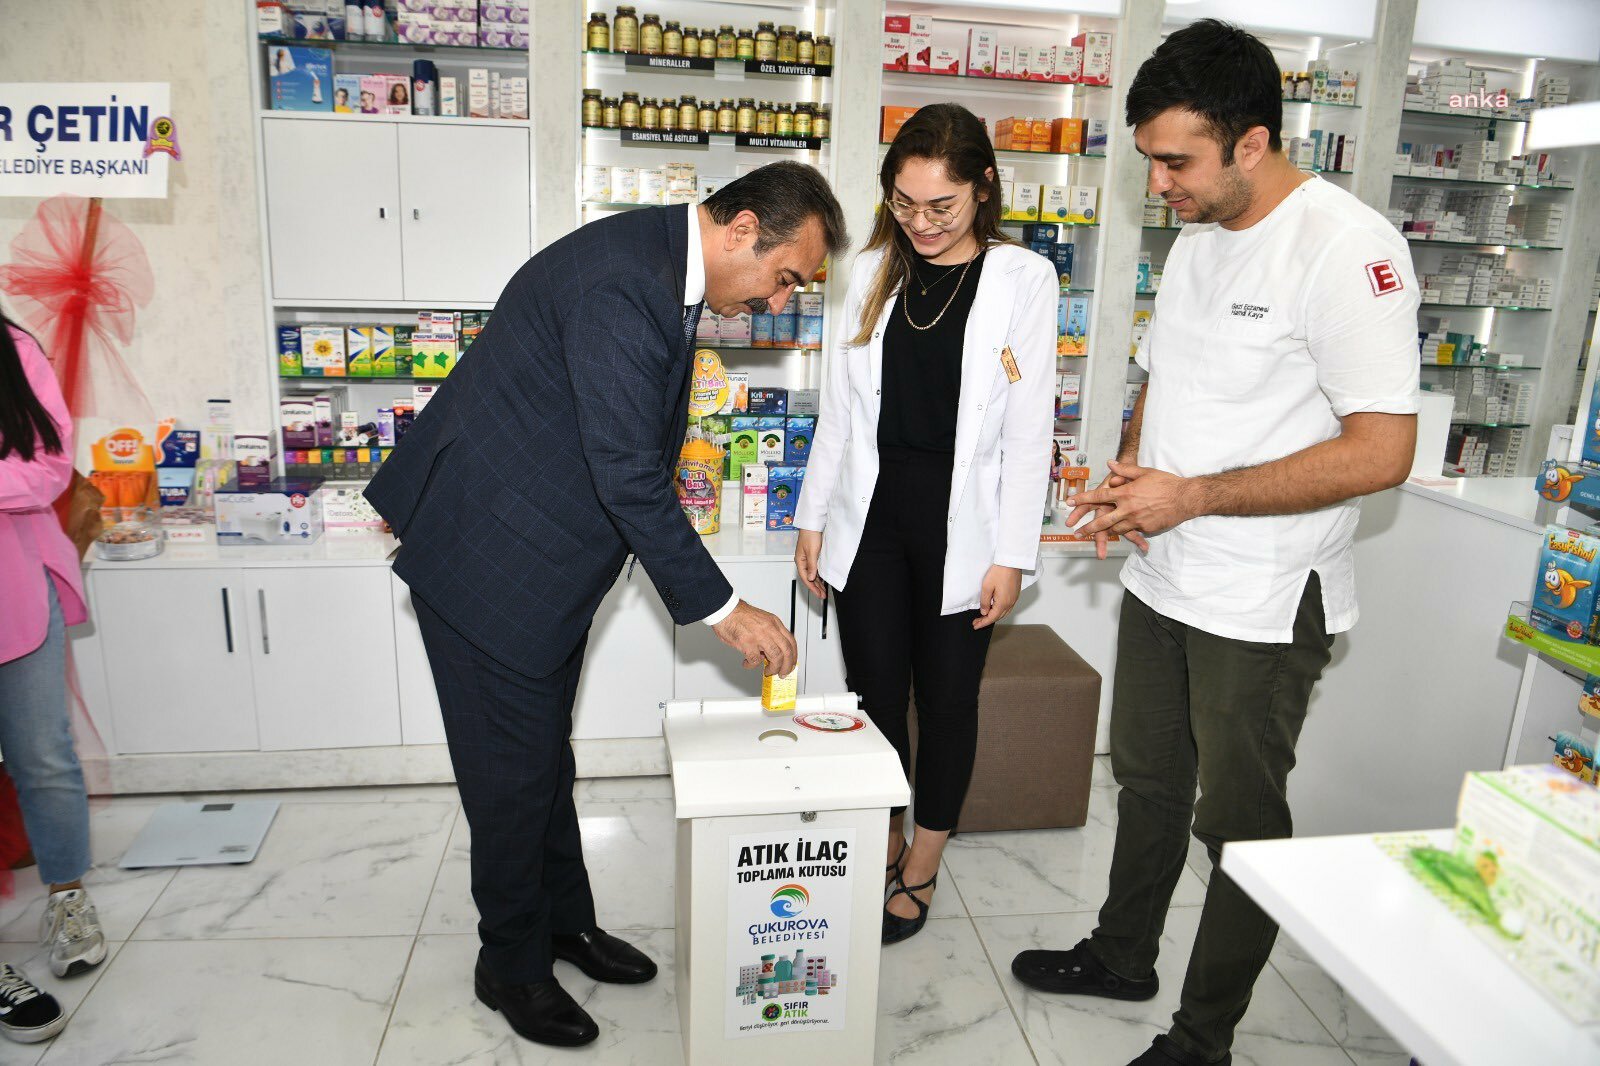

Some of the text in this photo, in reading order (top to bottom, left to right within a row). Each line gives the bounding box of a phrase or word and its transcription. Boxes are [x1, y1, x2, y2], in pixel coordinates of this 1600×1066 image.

[649, 58, 691, 68] MİNERALLER
[760, 63, 816, 75] ÖZEL TAKVİYELER
[27, 95, 148, 153] ÇETİN
[632, 132, 699, 144] ESANSİYEL YAĞ ASİTLERİ
[749, 137, 807, 149] MULTİ VİTAMİNLER
[70, 159, 148, 179] BAŞKANI
[1371, 264, 1397, 291] E
[105, 439, 140, 453] OFF!
[737, 837, 848, 868] ATIK İLAÇ
[737, 865, 847, 884] TOPLAMA KUTUSU
[748, 918, 829, 937] ÇUKUROVA
[752, 930, 825, 946] BELEDİYESİ
[783, 1001, 809, 1011] SIFIR
[783, 1009, 809, 1019] ATIK
